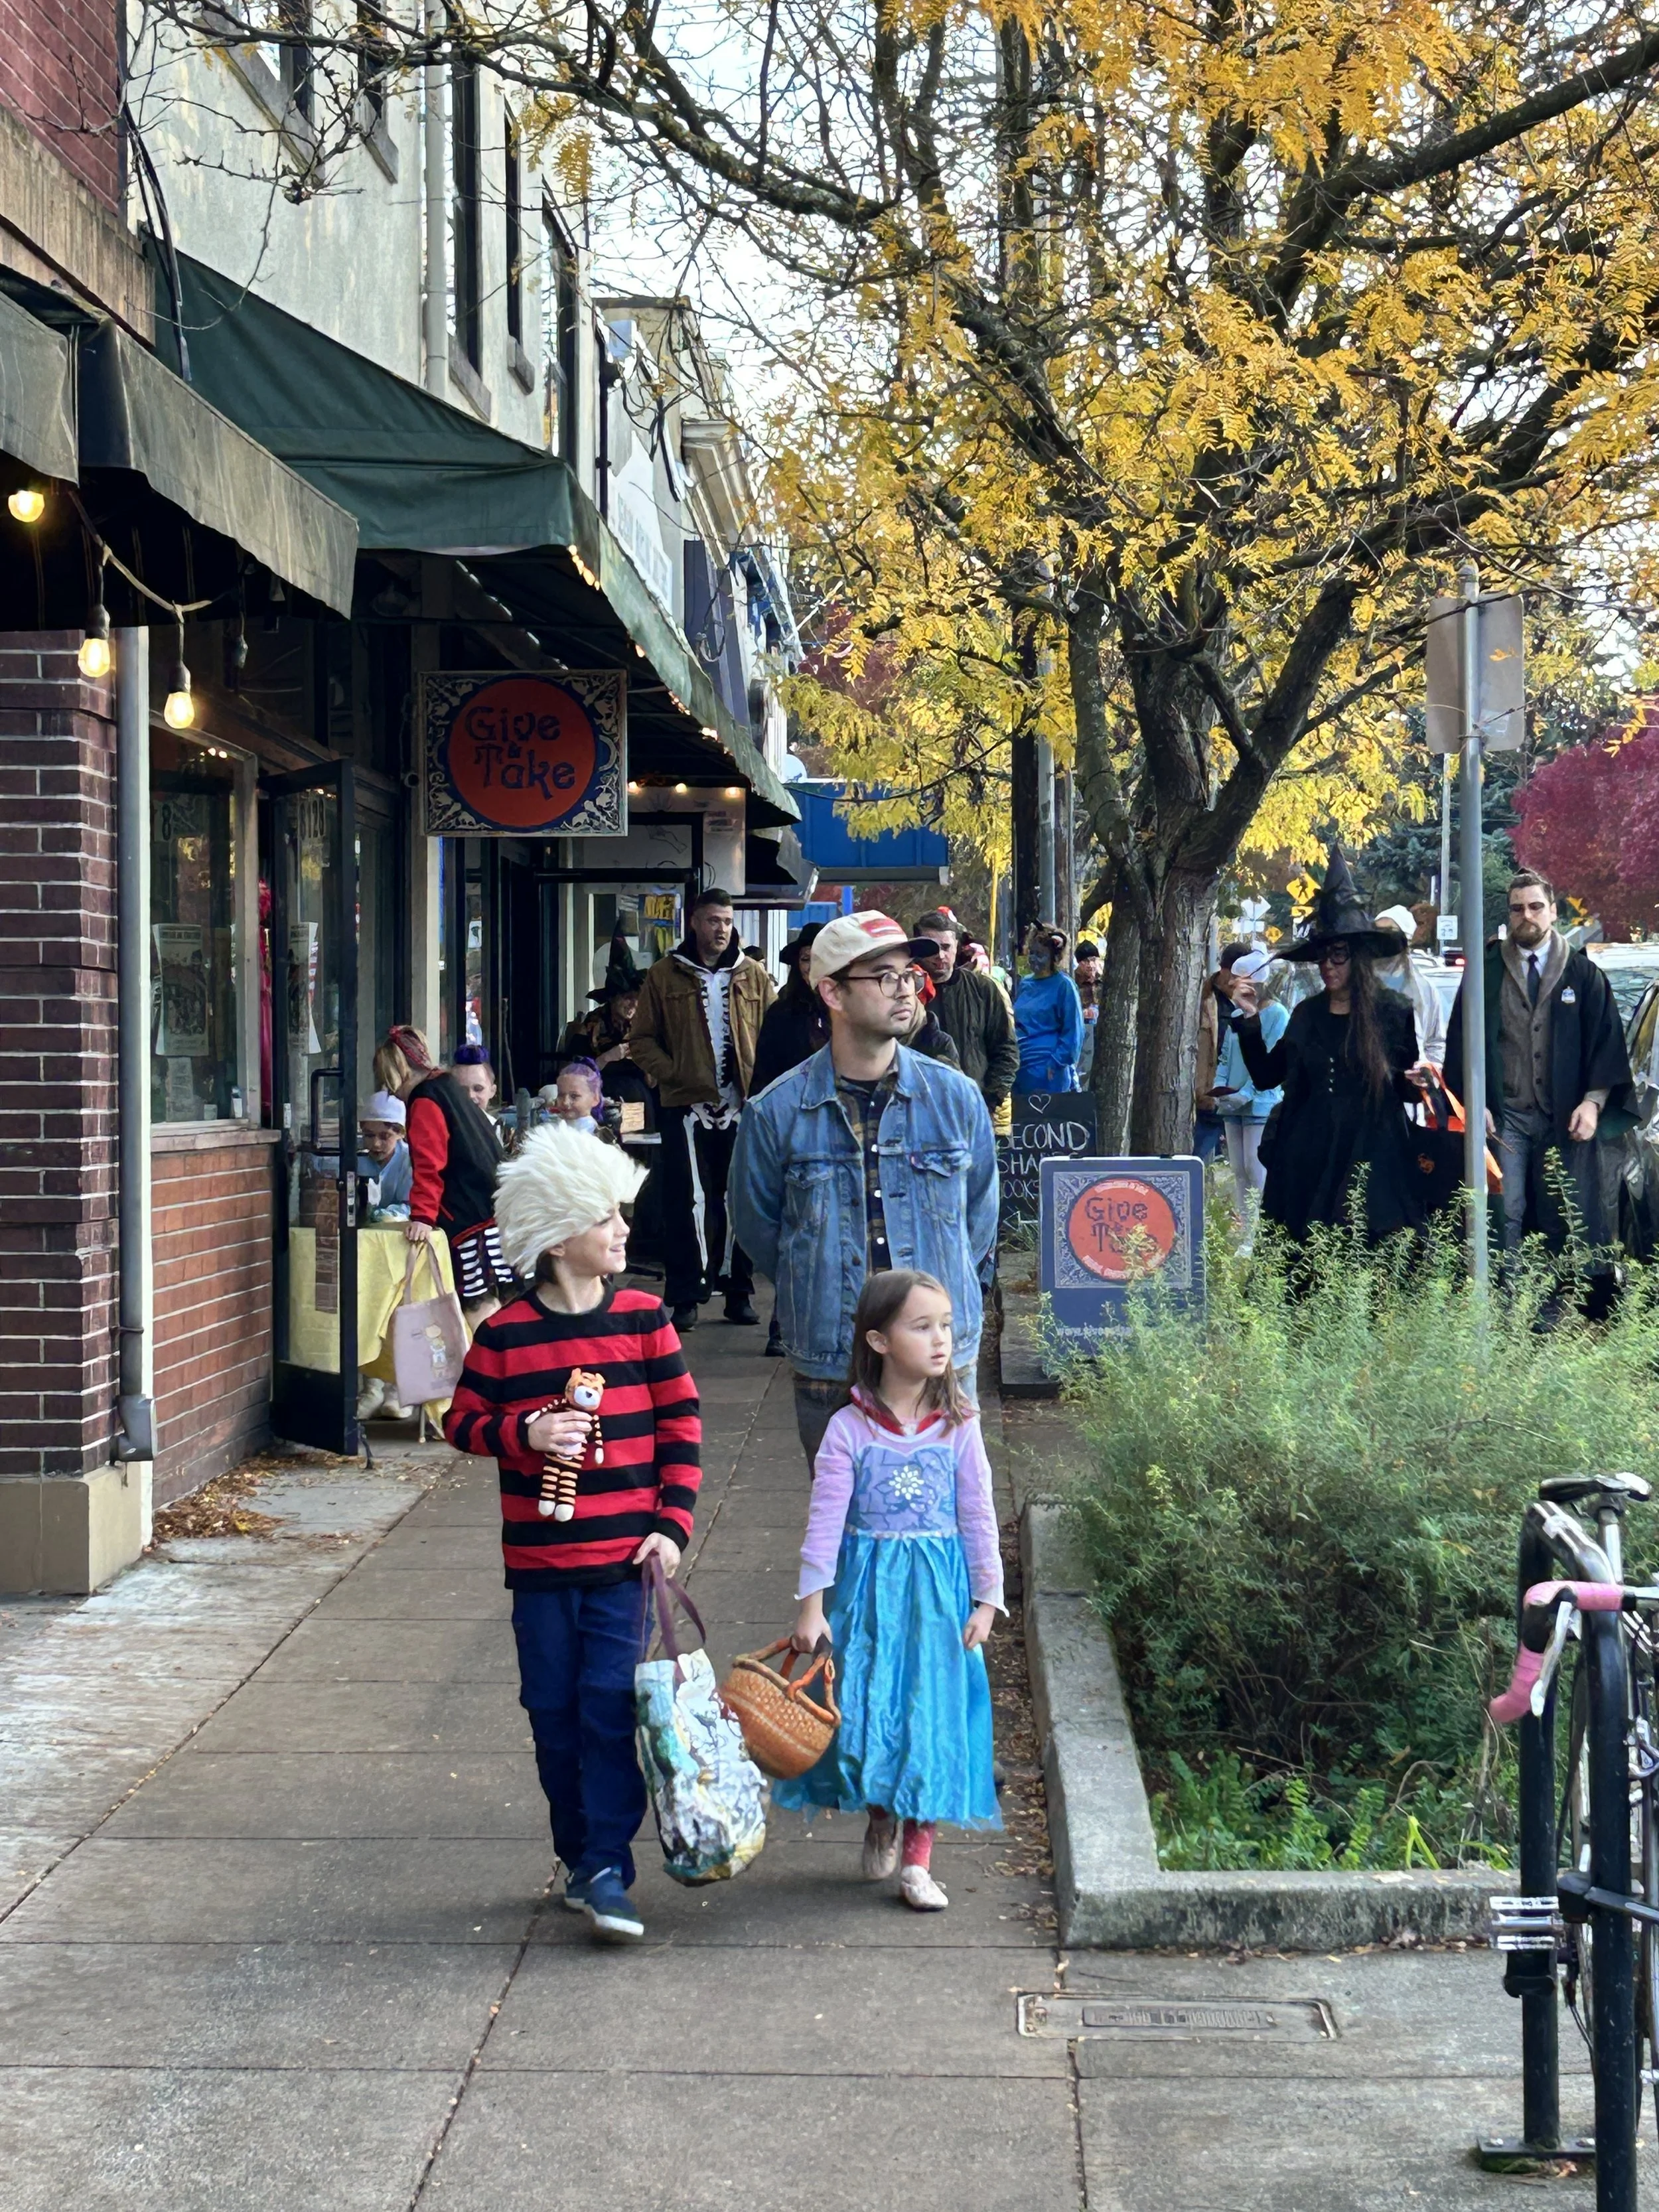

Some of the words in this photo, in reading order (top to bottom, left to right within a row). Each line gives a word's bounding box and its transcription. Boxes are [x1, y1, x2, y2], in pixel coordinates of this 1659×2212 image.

[467, 705, 561, 742] Give
[474, 743, 575, 800] Take
[1085, 1197, 1148, 1221] Give
